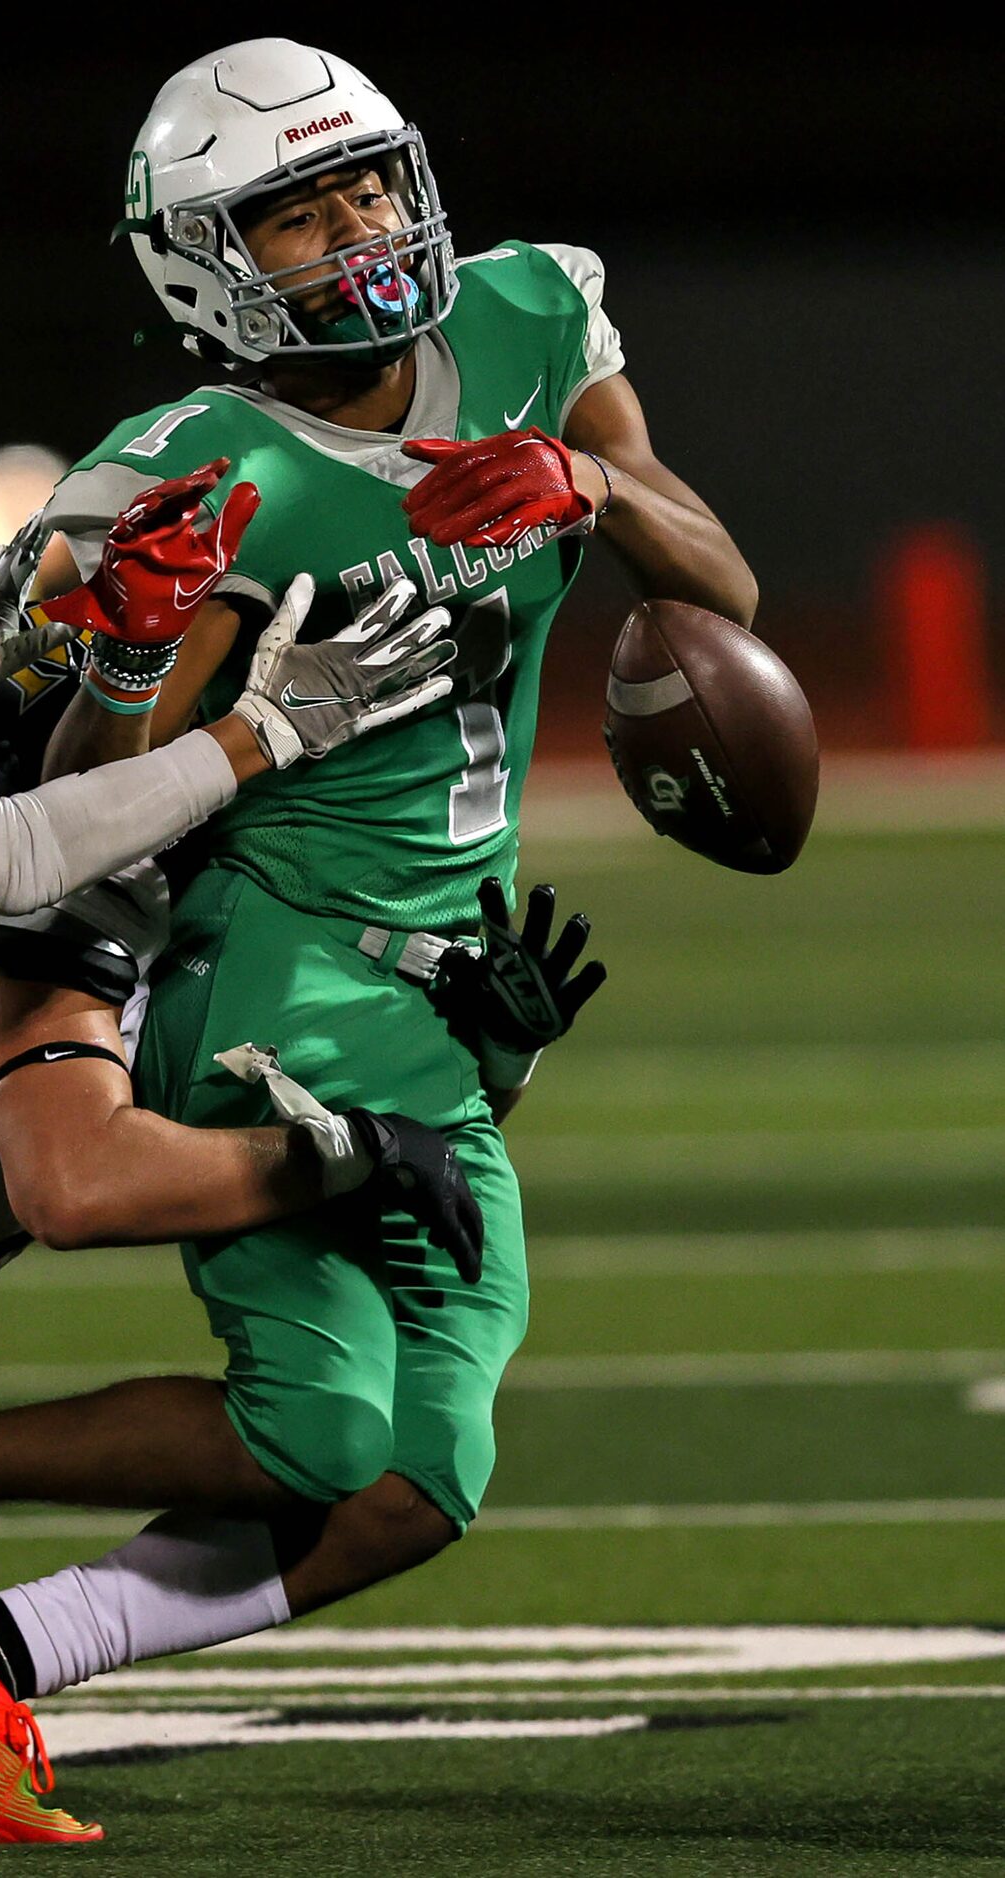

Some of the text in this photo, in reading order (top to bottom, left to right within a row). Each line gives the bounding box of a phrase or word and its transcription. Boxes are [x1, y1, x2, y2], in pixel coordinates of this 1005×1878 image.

[284, 110, 354, 144] Riddell
[119, 405, 211, 457] 1
[449, 585, 513, 846] 1
[690, 748, 733, 817] TEAM ISSUE
